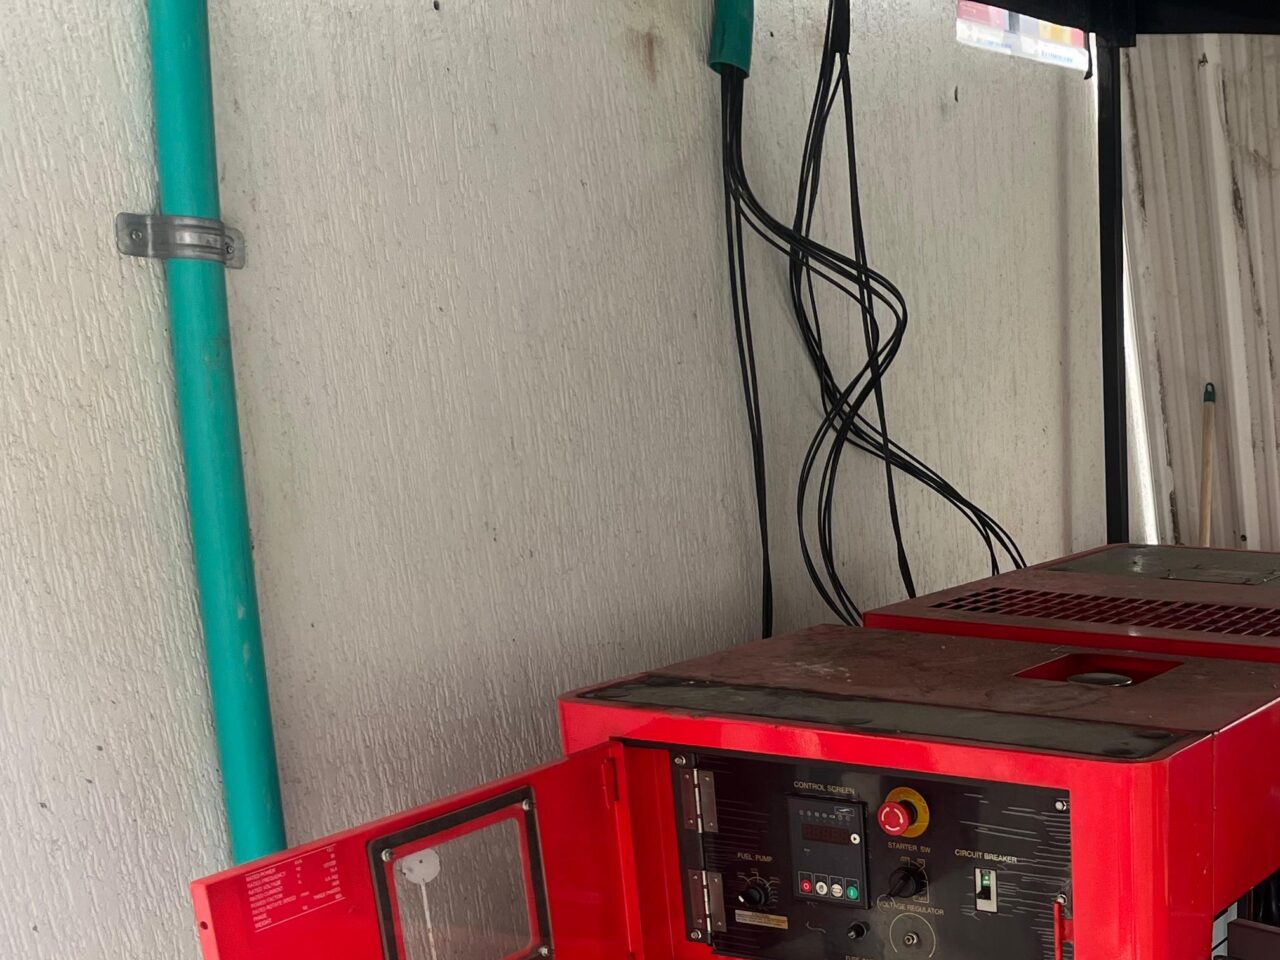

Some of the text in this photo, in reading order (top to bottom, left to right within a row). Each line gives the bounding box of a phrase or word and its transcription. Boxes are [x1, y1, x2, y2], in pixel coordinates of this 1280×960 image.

[793, 781, 855, 794] CONTROL SCREEN
[888, 842, 917, 852] STARTER
[737, 852, 752, 860] FUEL
[954, 848, 1017, 864] CIRCUIT BREAKER
[907, 904, 944, 916] REGULATOR
